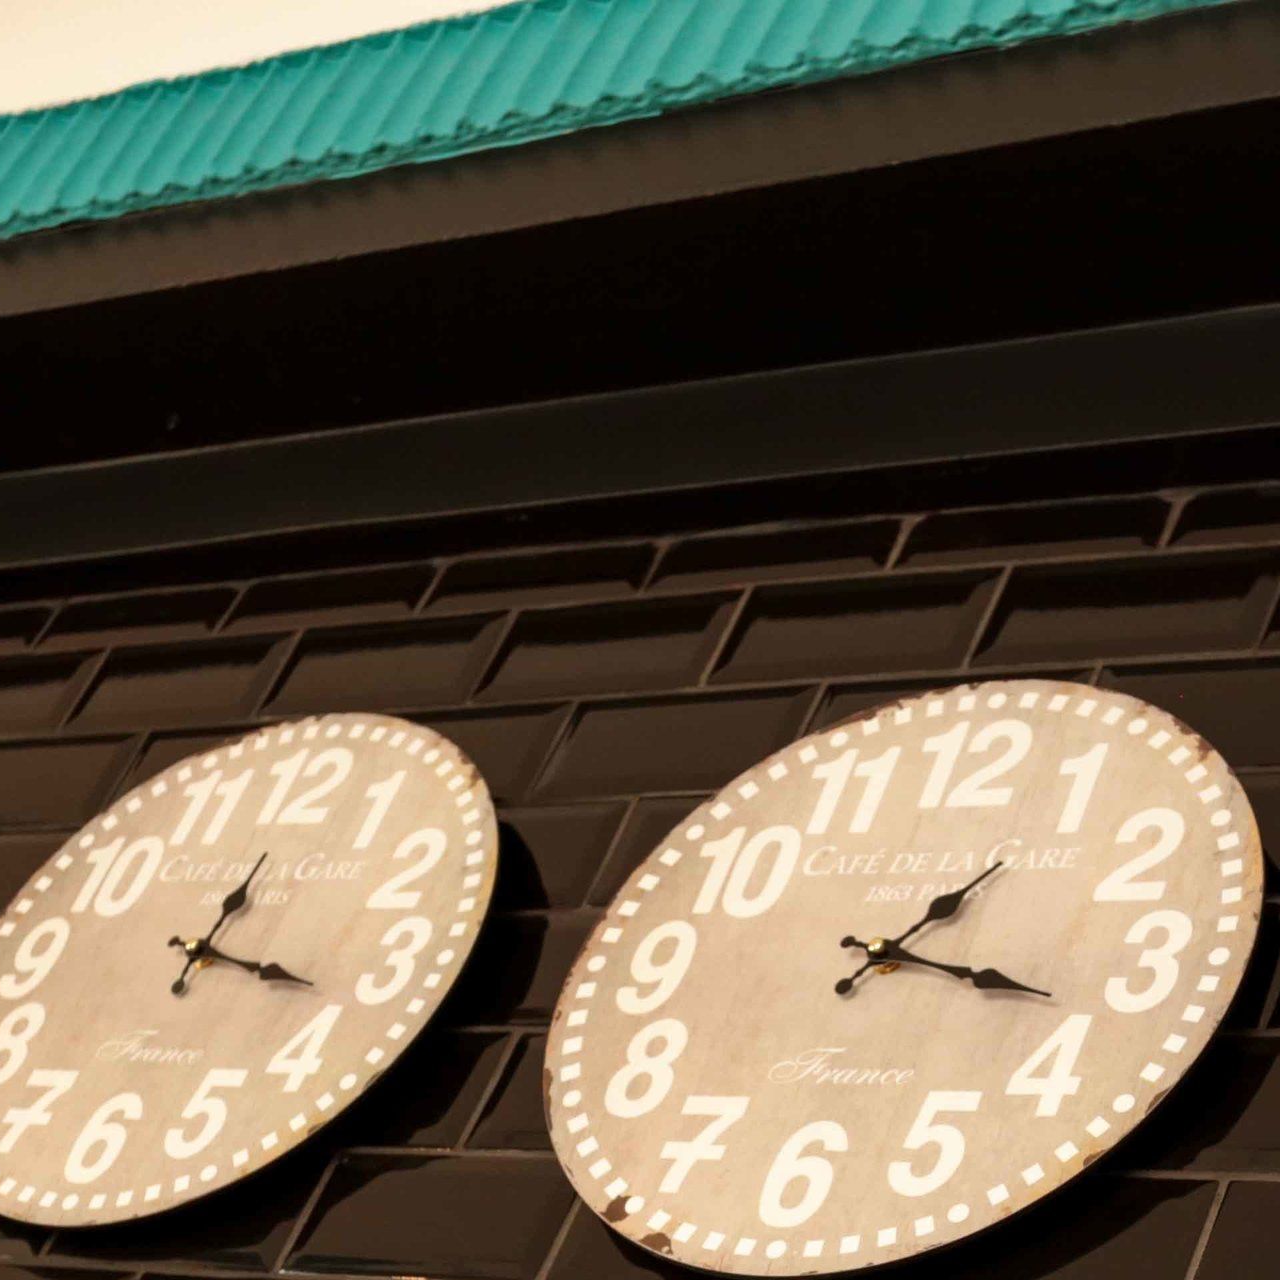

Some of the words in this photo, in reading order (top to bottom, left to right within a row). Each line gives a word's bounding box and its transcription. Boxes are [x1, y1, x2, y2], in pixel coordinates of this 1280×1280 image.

[170, 769, 253, 845] 11
[257, 748, 353, 824] 12
[806, 747, 901, 834] 11
[918, 719, 1032, 808] 12
[1057, 742, 1108, 833] 1
[353, 770, 406, 849] 1
[1094, 807, 1185, 901] 2
[71, 837, 164, 917] 10
[294, 853, 365, 880] GARE
[367, 827, 447, 909] 2
[693, 825, 801, 918] 10
[803, 845, 886, 876] CAFÉ
[889, 852, 932, 874] DE
[937, 851, 973, 873] LA
[984, 838, 1082, 871] GARE
[865, 884, 914, 901] 1863
[355, 916, 432, 1005] 3
[616, 920, 697, 1015] 9
[1105, 909, 1193, 1013] 3
[265, 1004, 342, 1092] 4
[604, 1018, 688, 1118] 8
[767, 1046, 915, 1085] France
[1006, 1014, 1092, 1116] 4
[64, 1092, 143, 1184] 6
[164, 1067, 248, 1160] 5
[659, 1095, 750, 1193] 7
[887, 1091, 982, 1197] 5
[758, 1121, 848, 1227] 6
